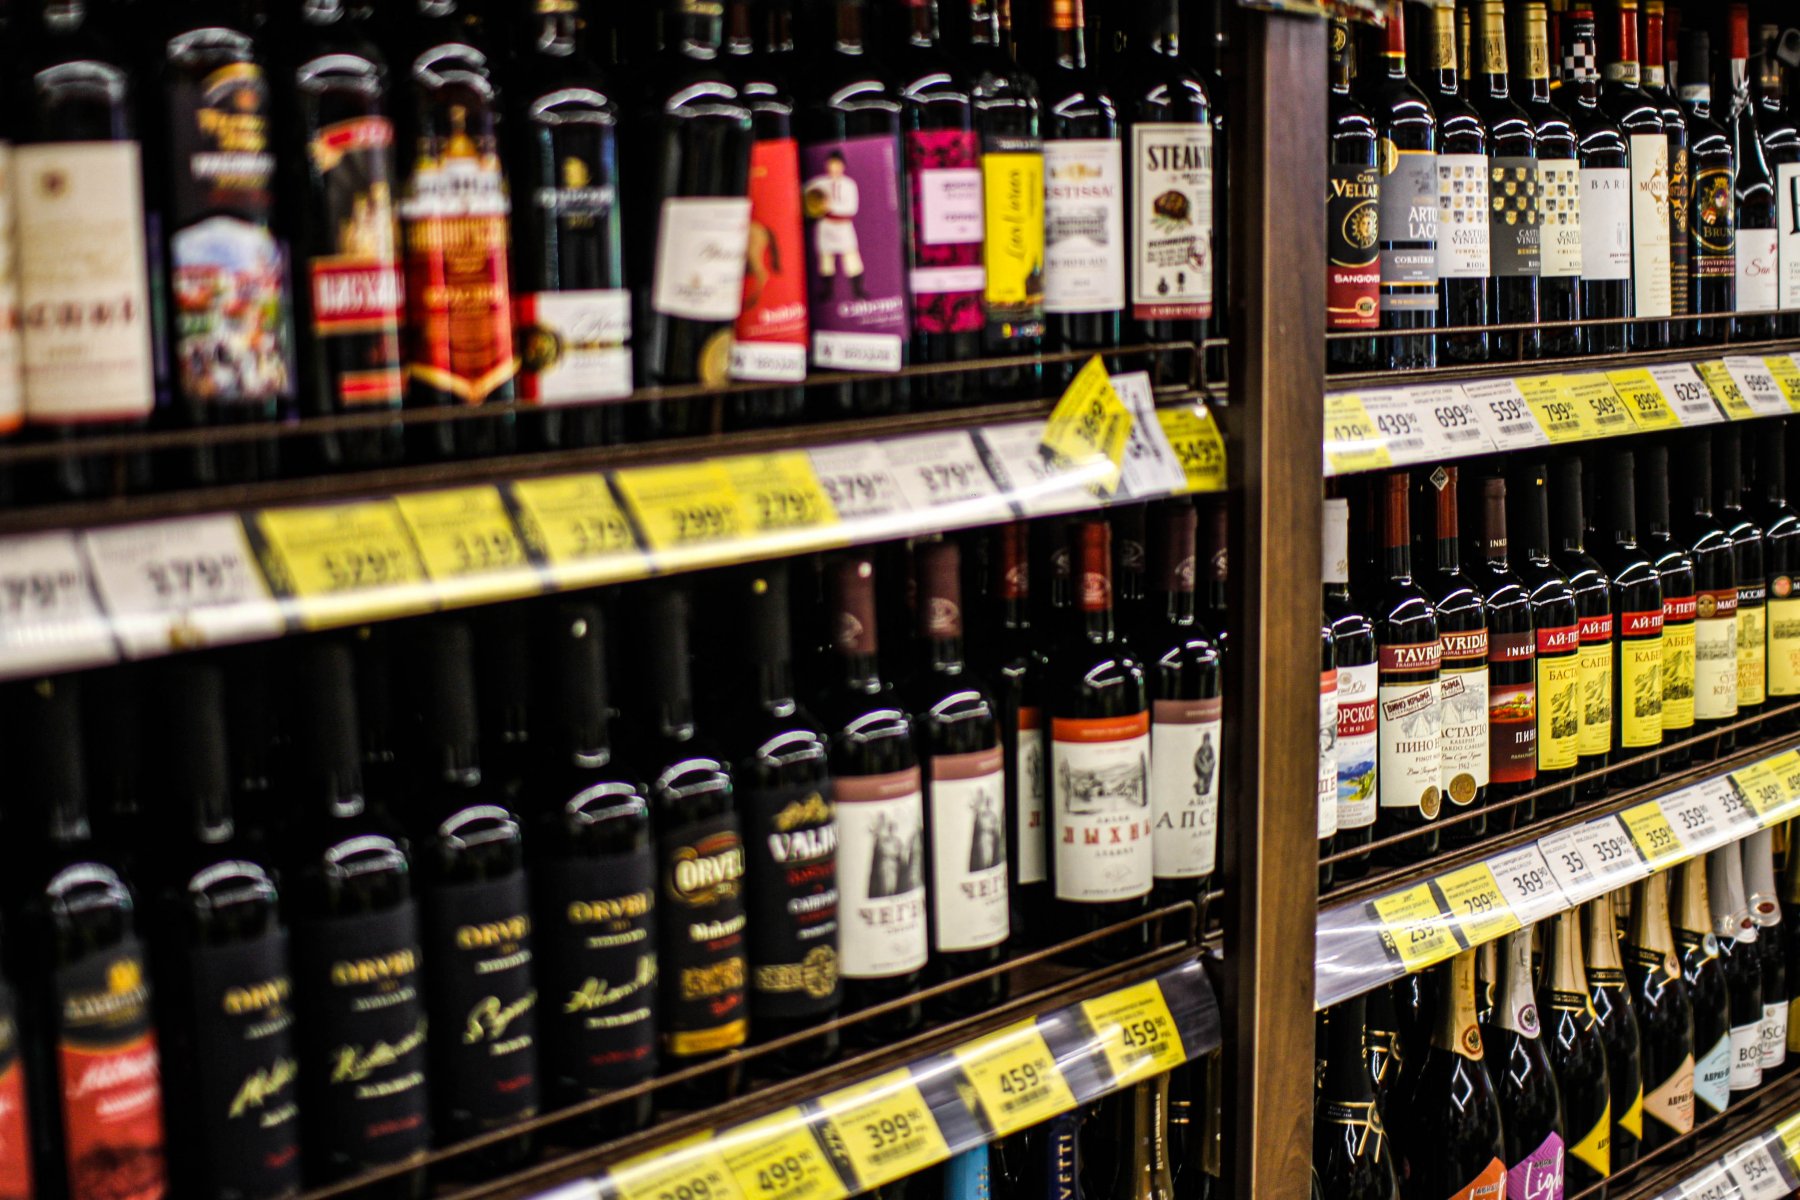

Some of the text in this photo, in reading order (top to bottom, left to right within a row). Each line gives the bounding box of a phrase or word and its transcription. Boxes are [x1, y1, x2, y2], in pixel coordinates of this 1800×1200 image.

[1434, 405, 1467, 428] 699
[1489, 400, 1521, 421] 559
[1542, 402, 1570, 422] 799
[1589, 396, 1617, 416] 549
[1377, 413, 1411, 434] 439
[1679, 806, 1706, 830] 359
[1646, 826, 1671, 848] 359
[1592, 838, 1622, 862] 359
[1512, 869, 1544, 896] 369
[1463, 891, 1492, 915] 299
[1122, 1018, 1158, 1048] 459
[999, 1063, 1040, 1095] 459
[864, 1112, 912, 1149] 399
[757, 1155, 804, 1191] 499
